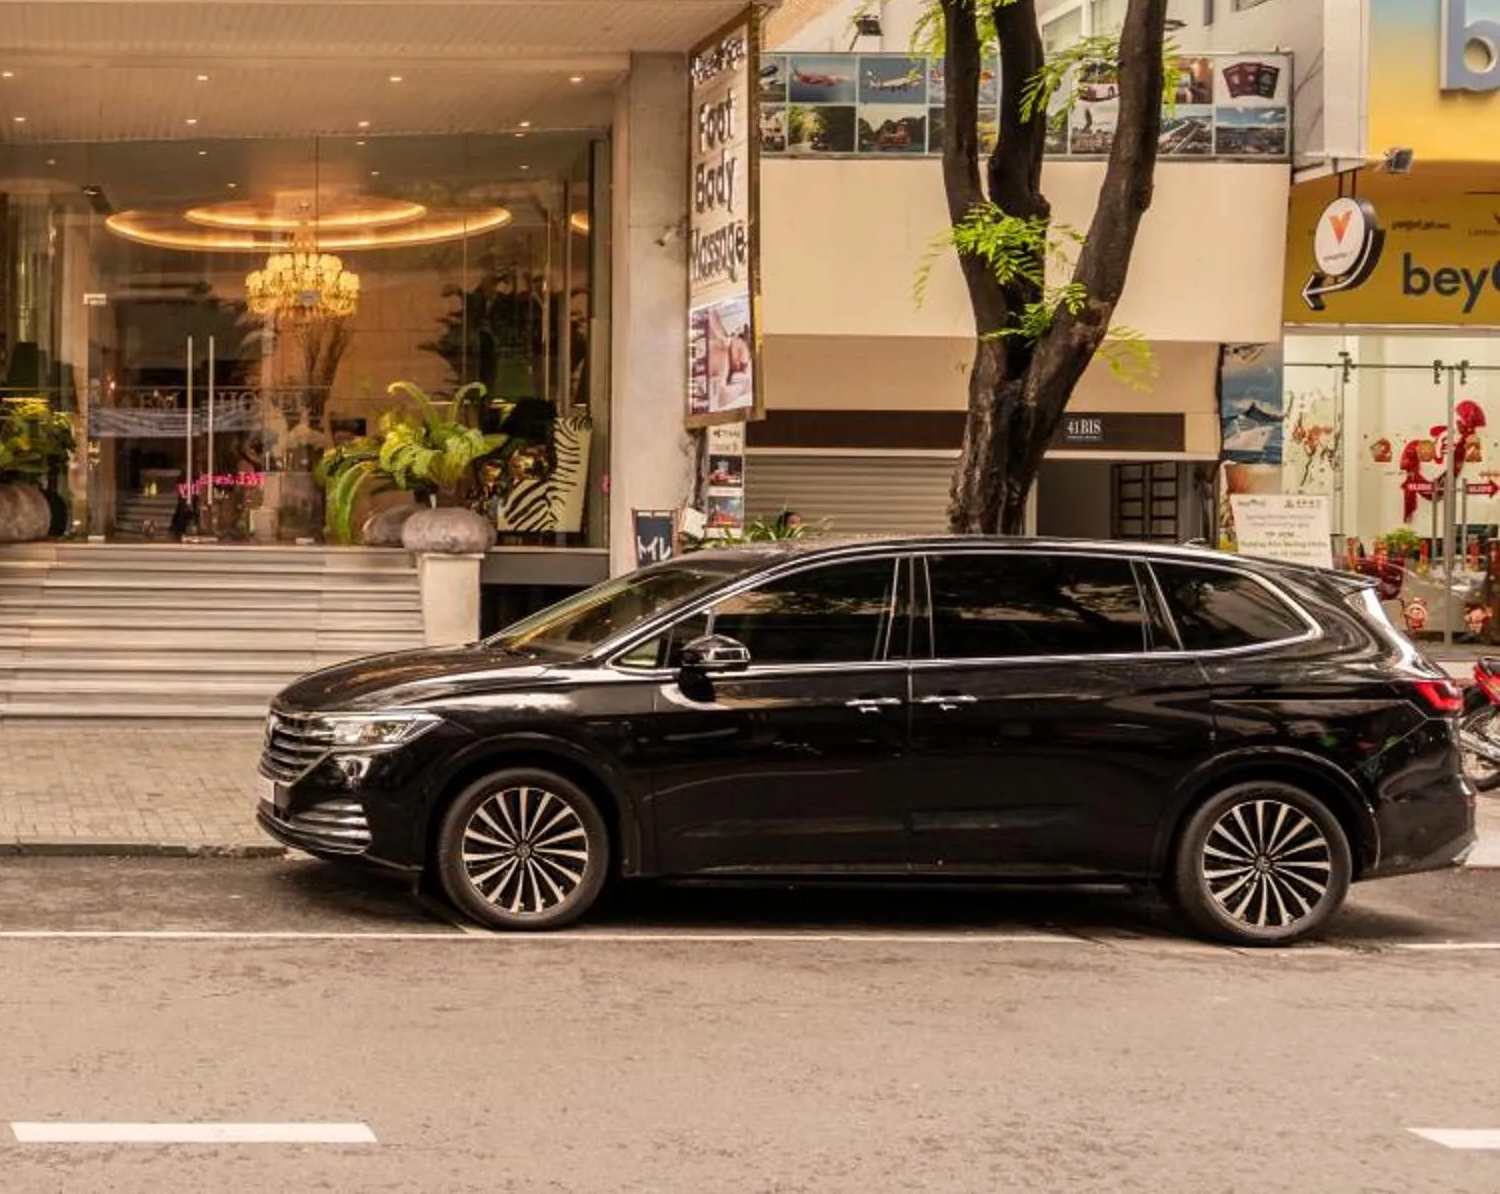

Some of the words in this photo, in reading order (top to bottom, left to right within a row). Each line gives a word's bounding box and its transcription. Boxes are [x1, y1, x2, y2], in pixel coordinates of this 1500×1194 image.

[699, 87, 736, 152] Foot
[695, 149, 737, 213] Body
[690, 218, 748, 283] Massage
[1403, 252, 1500, 314] bey
